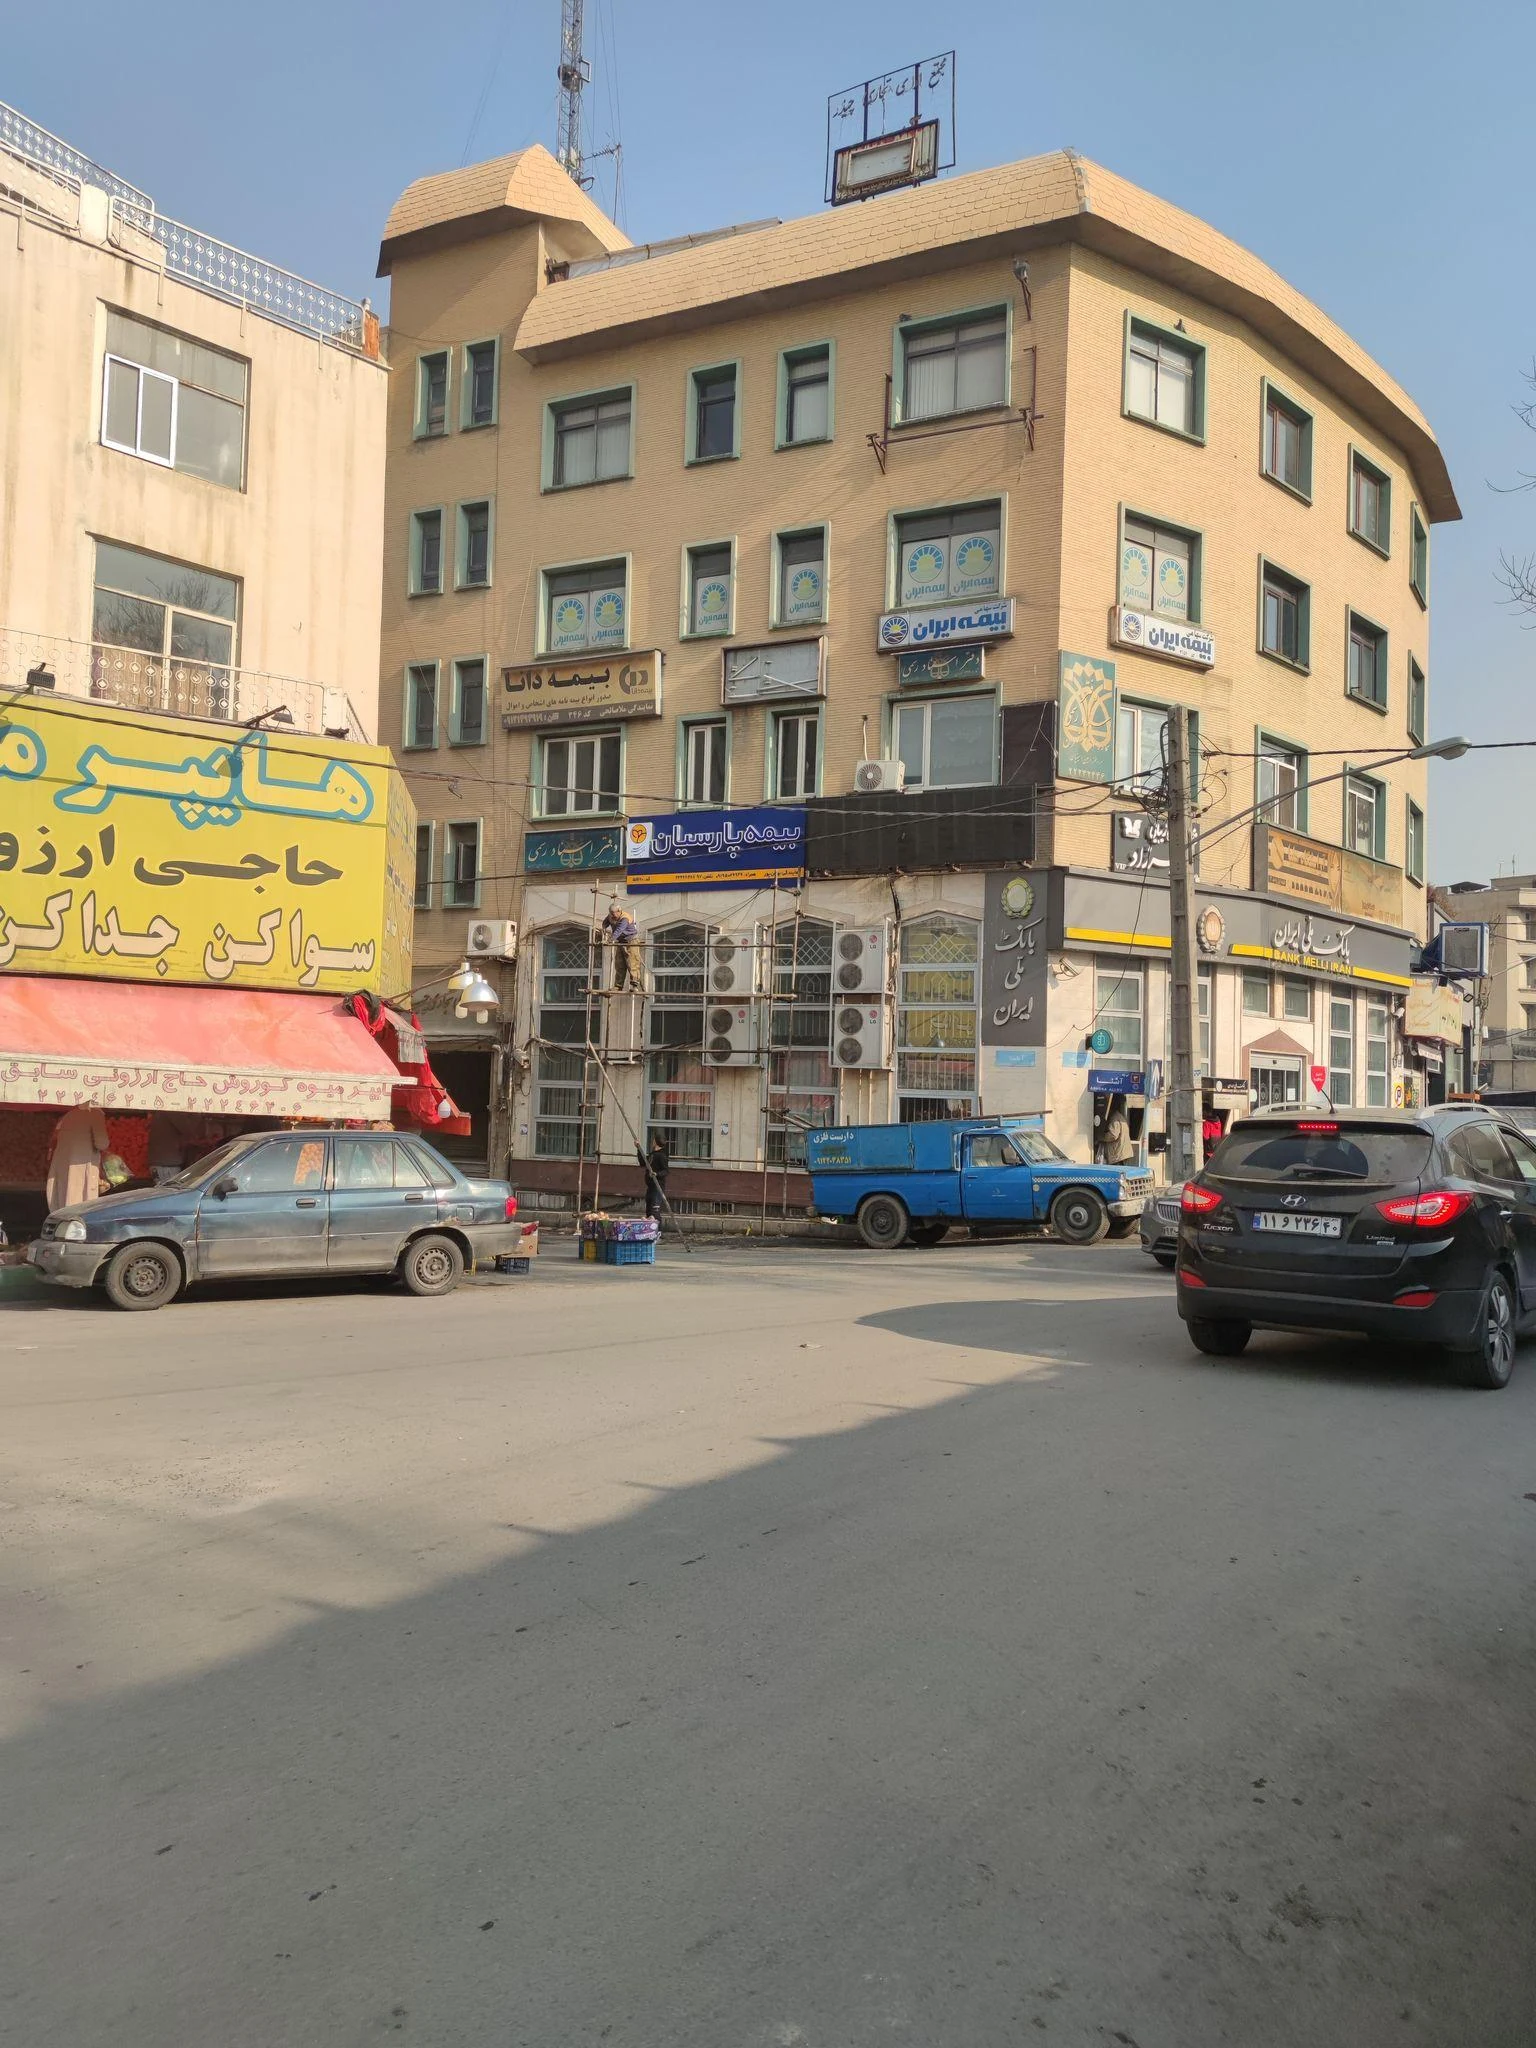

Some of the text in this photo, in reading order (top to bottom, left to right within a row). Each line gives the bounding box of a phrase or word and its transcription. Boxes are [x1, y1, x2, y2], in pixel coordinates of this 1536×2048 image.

[913, 612, 1007, 641] بیمه ایران
[1148, 627, 1180, 652] ایران
[1180, 636, 1211, 661] بیمه
[902, 651, 980, 678] دفتر اسناد رسمی
[504, 667, 611, 693] بیمه دانا
[627, 703, 654, 715] نمایندگی
[54, 728, 374, 830] هایپر
[528, 833, 618, 862] دفتر اسناد رسمی
[651, 821, 801, 859] بیمه پارسیان
[133, 844, 345, 895] حاجی
[1114, 862, 1127, 870] VIP
[995, 916, 1045, 955] بانک
[1274, 915, 1356, 965] بانک ملی ایران
[1004, 956, 1025, 990] ملی
[1274, 948, 1352, 976] BANK MELLI IRAN
[993, 996, 1034, 1027] ایران
[0, 1062, 392, 1102] ایپر میوه کوروش حاج ارزونی سابق
[1096, 1075, 1124, 1085] آشنا
[813, 1131, 855, 1144] داربست فلزی
[1202, 1223, 1234, 1232] Tucson
[1263, 1213, 1276, 1228] ۱۱
[1294, 1216, 1320, 1231] ۲۳۶
[1322, 1221, 1338, 1234] ۴۰
